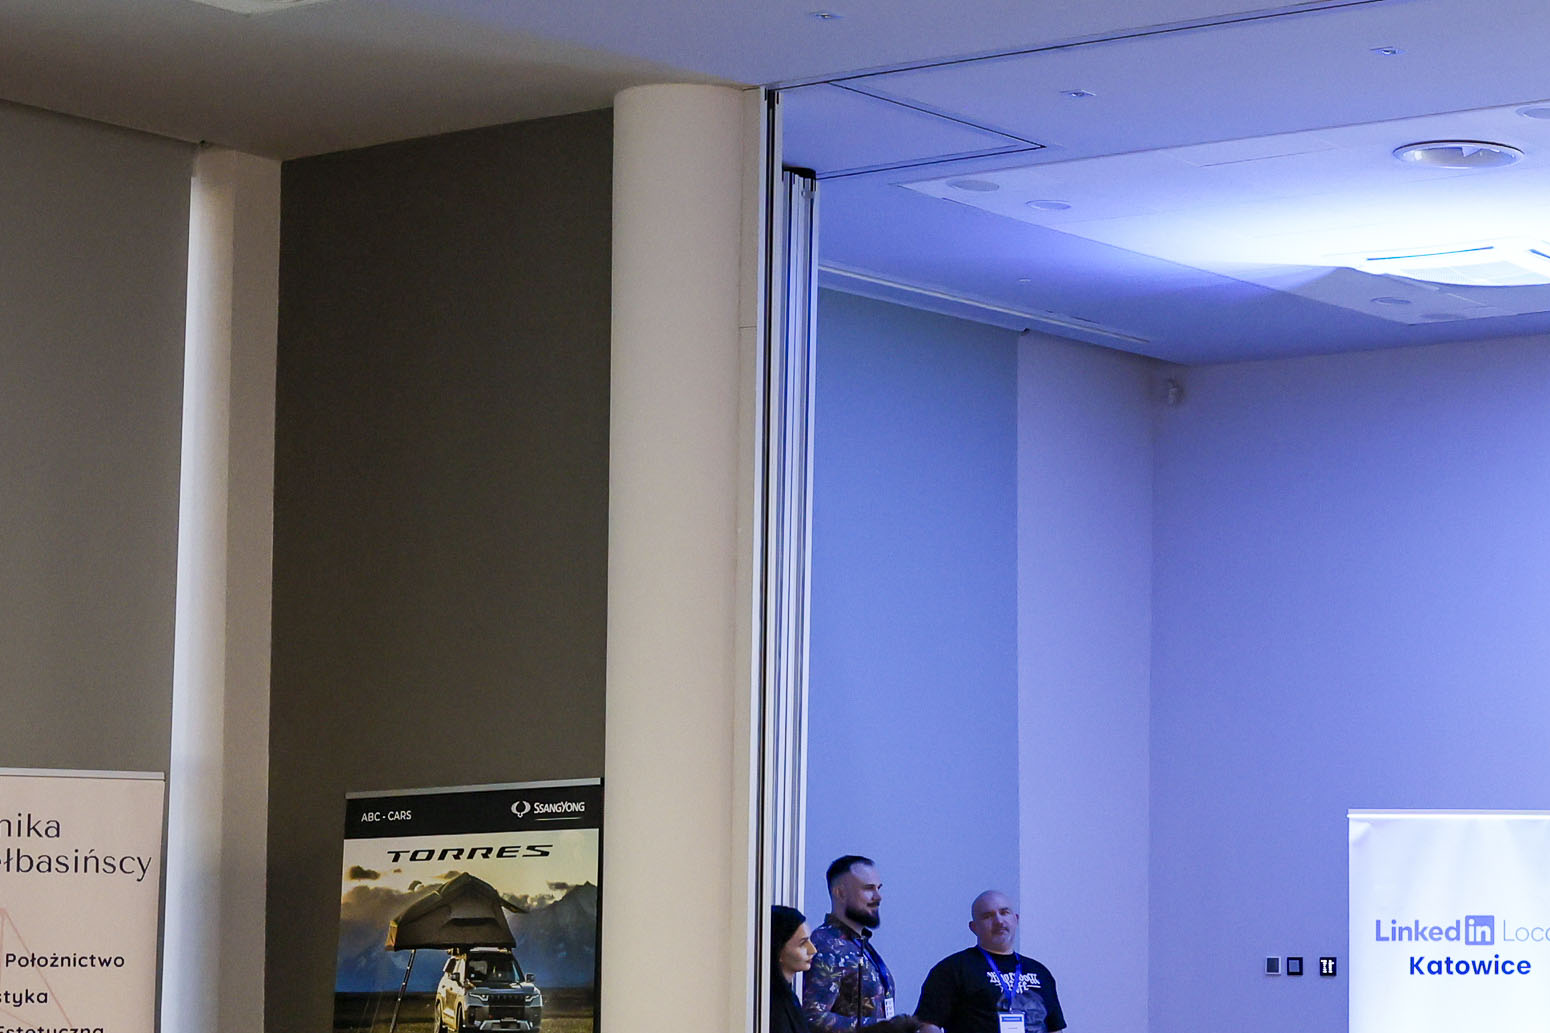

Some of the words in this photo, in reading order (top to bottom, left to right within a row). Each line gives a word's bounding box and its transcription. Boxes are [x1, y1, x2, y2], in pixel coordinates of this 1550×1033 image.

[361, 811, 381, 822] ABC
[387, 810, 413, 821] CARS
[387, 844, 554, 863] TORRES
[0, 848, 152, 882] łbasińscy
[5, 952, 125, 968] Położnictwo
[1409, 954, 1532, 976] Katowice
